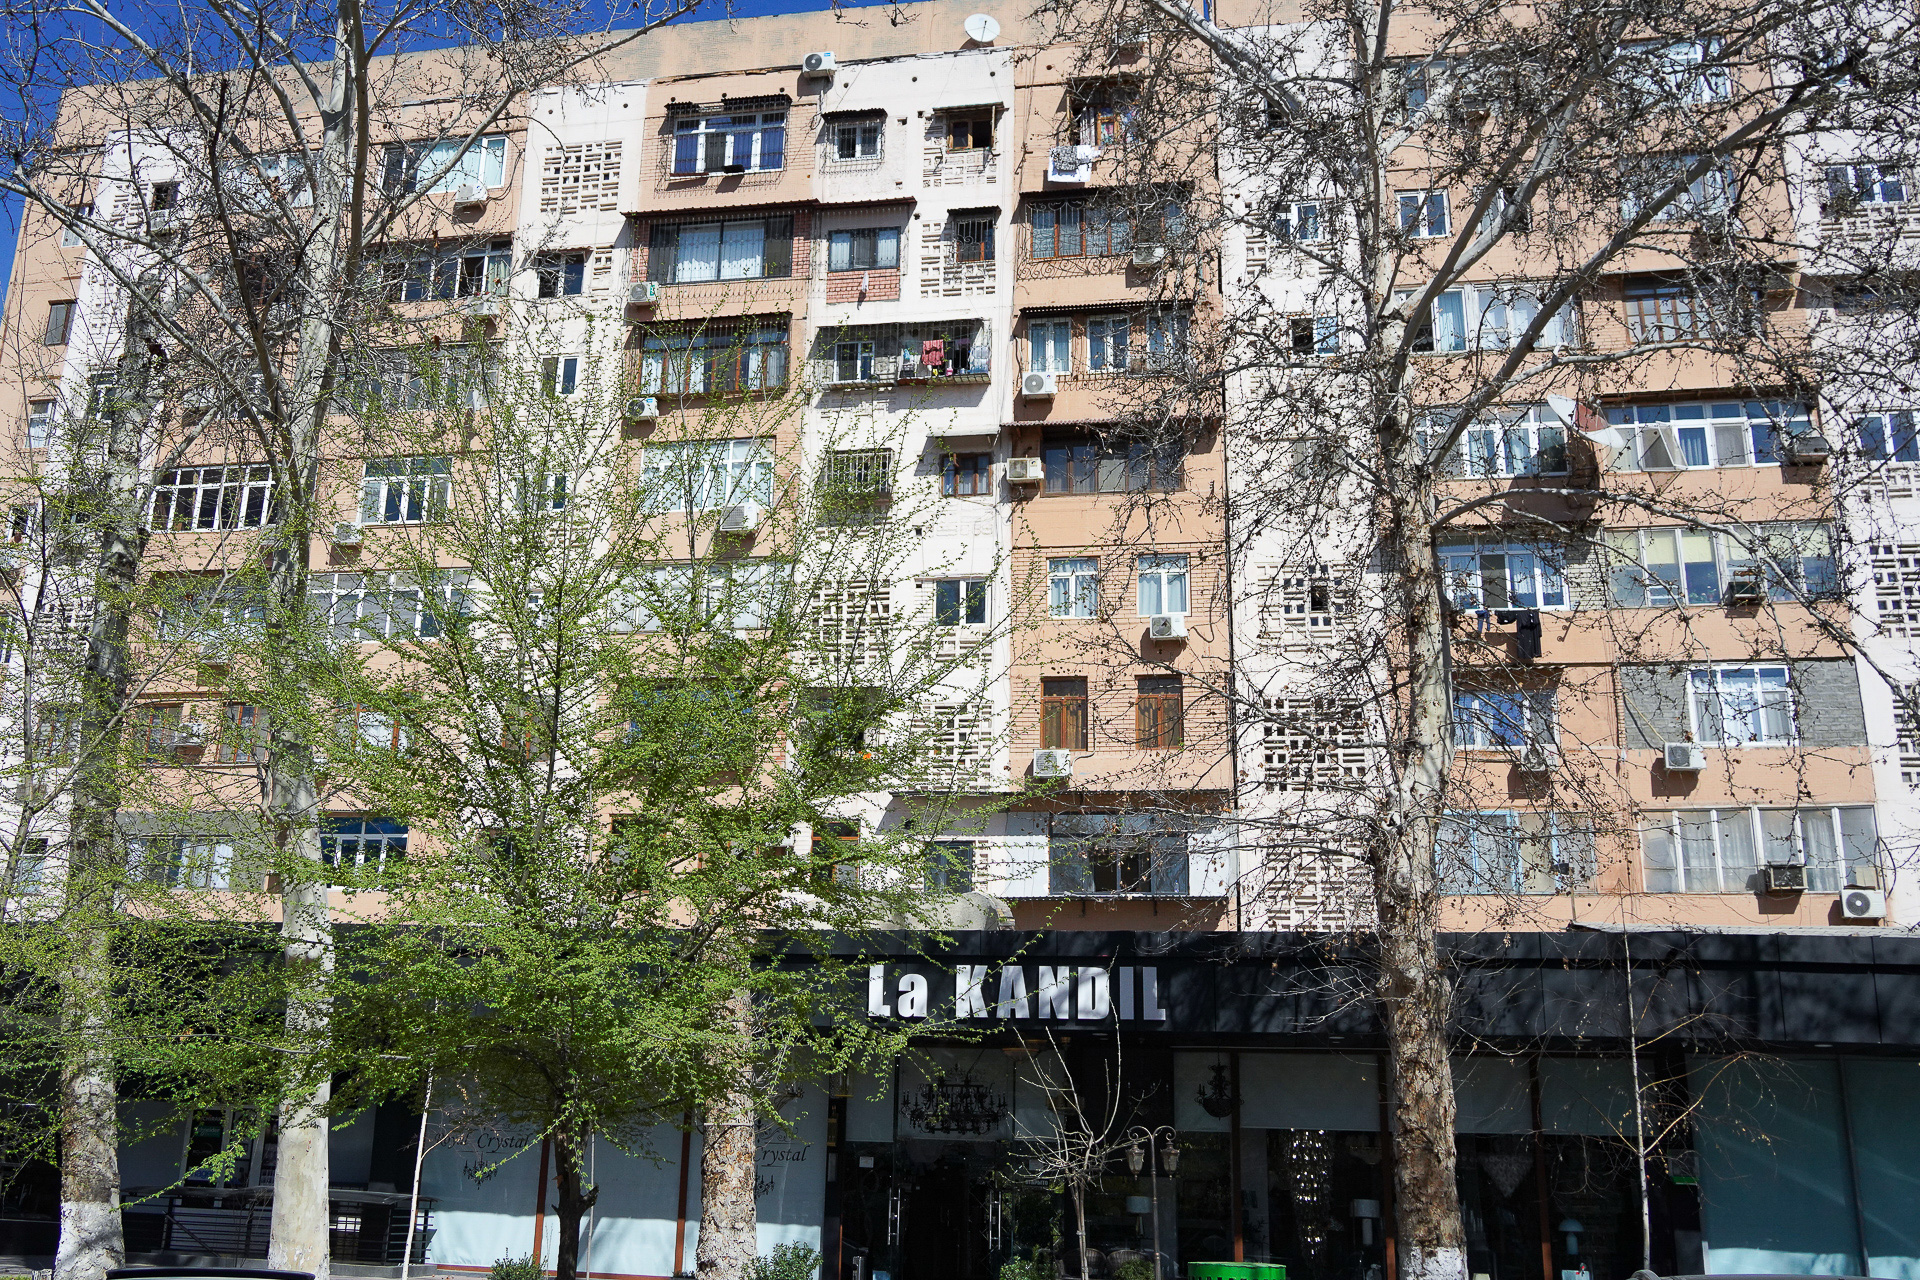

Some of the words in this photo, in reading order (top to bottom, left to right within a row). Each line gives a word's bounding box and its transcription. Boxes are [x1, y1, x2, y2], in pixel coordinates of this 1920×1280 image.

[867, 964, 928, 1018] La
[955, 965, 1166, 1021] KANDIL
[477, 1132, 533, 1153] Crystal
